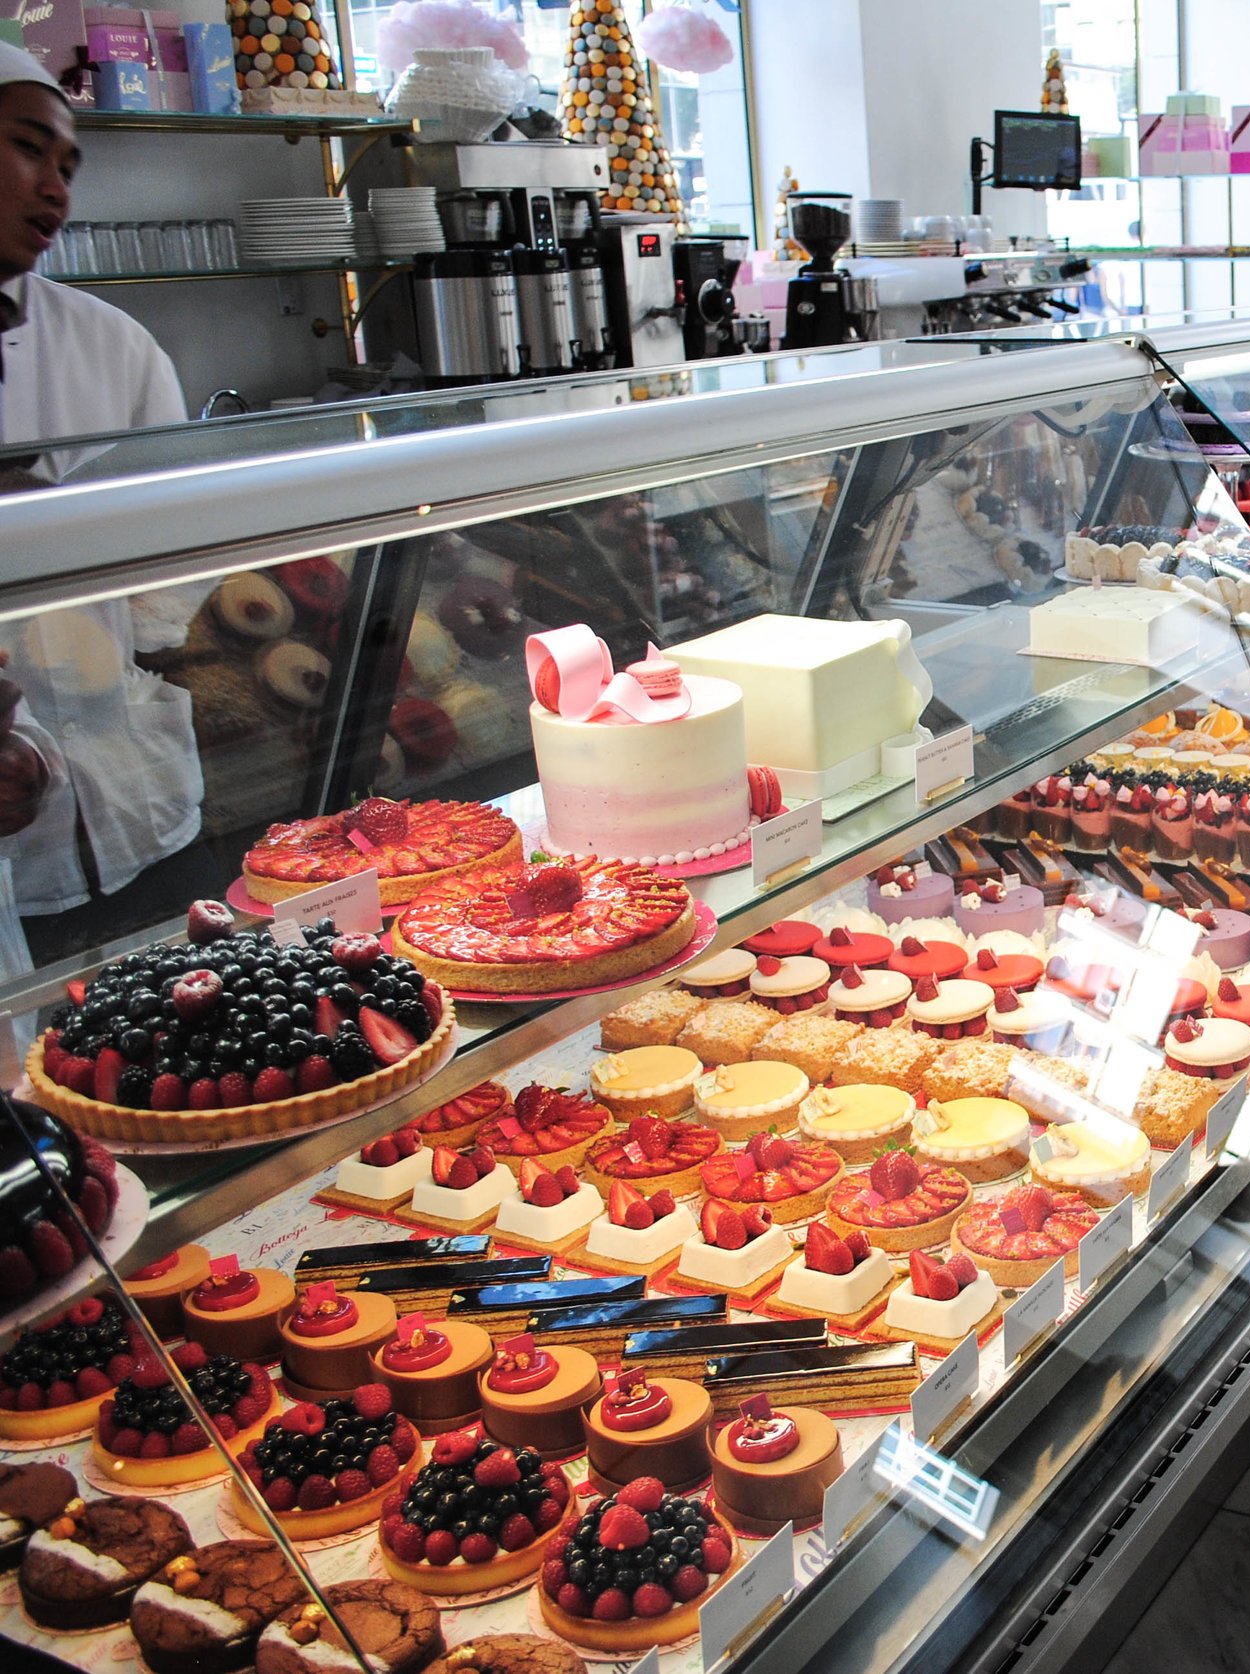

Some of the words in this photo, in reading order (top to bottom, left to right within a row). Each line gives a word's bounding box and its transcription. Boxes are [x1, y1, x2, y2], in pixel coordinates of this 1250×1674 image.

[109, 34, 138, 44] LOUIE
[302, 904, 321, 915] TARTE
[249, 1225, 310, 1262] Bottega
[934, 1373, 948, 1391] OPERA
[947, 1361, 959, 1377] CAKE
